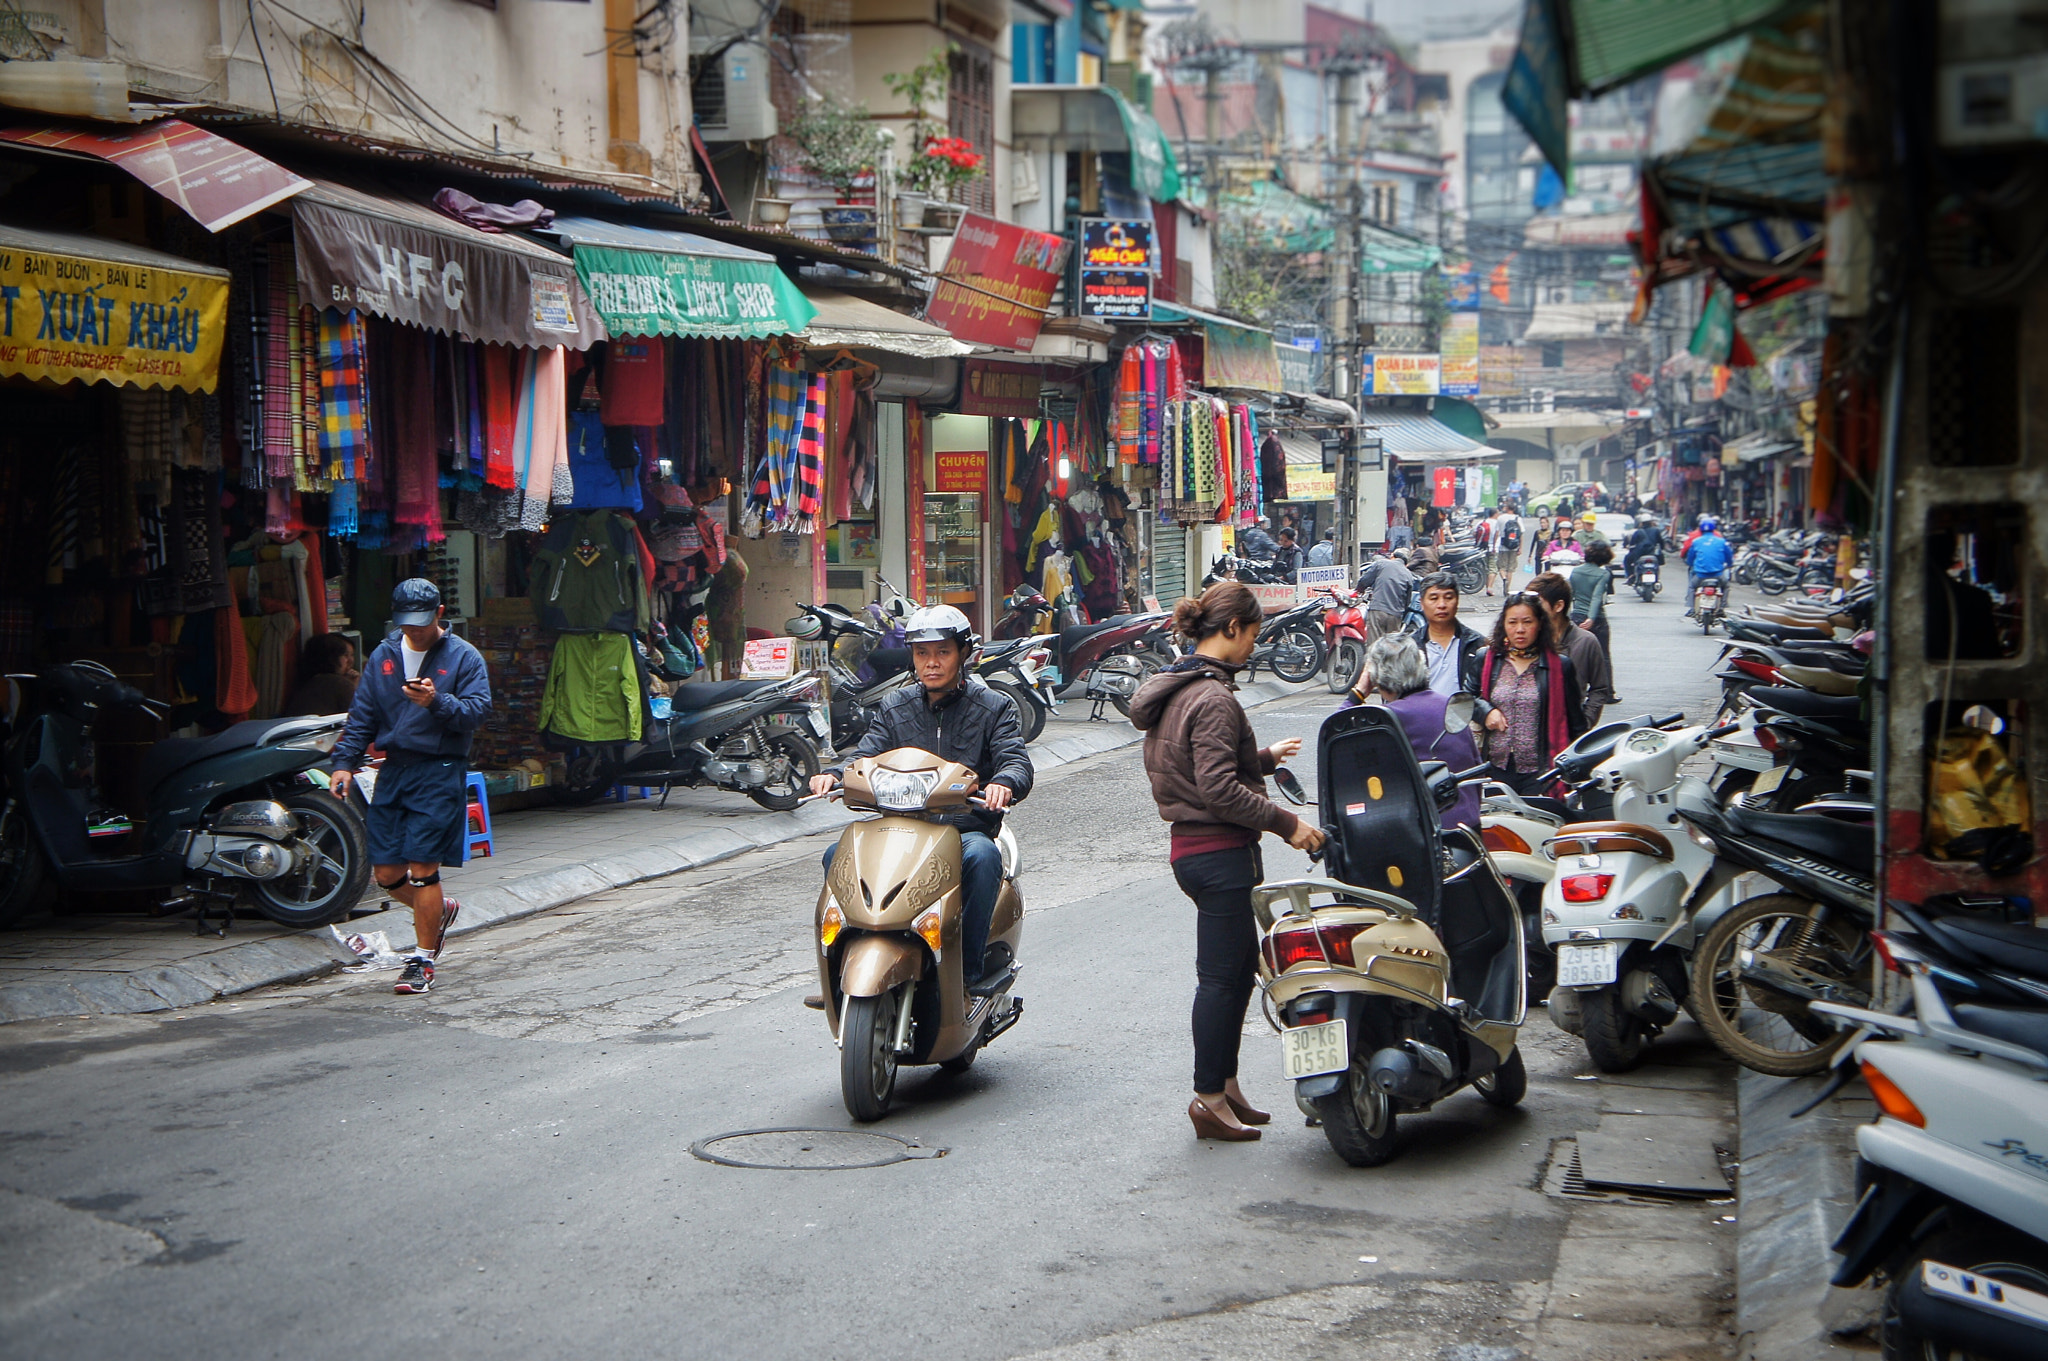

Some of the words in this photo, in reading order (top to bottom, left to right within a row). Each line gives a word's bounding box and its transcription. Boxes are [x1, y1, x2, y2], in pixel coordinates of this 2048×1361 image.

[56, 260, 91, 282] BUÔN
[331, 284, 352, 303] 5A
[682, 278, 729, 317] LUCKY
[733, 282, 777, 318] SHOP
[37, 283, 116, 346] XUẤT
[127, 286, 200, 354] KHẨU
[939, 454, 985, 467] CHUYÊN
[1301, 568, 1345, 583] MOTORBIKES
[1291, 1025, 1337, 1052] 30-K6
[1292, 1047, 1338, 1074] 0556
